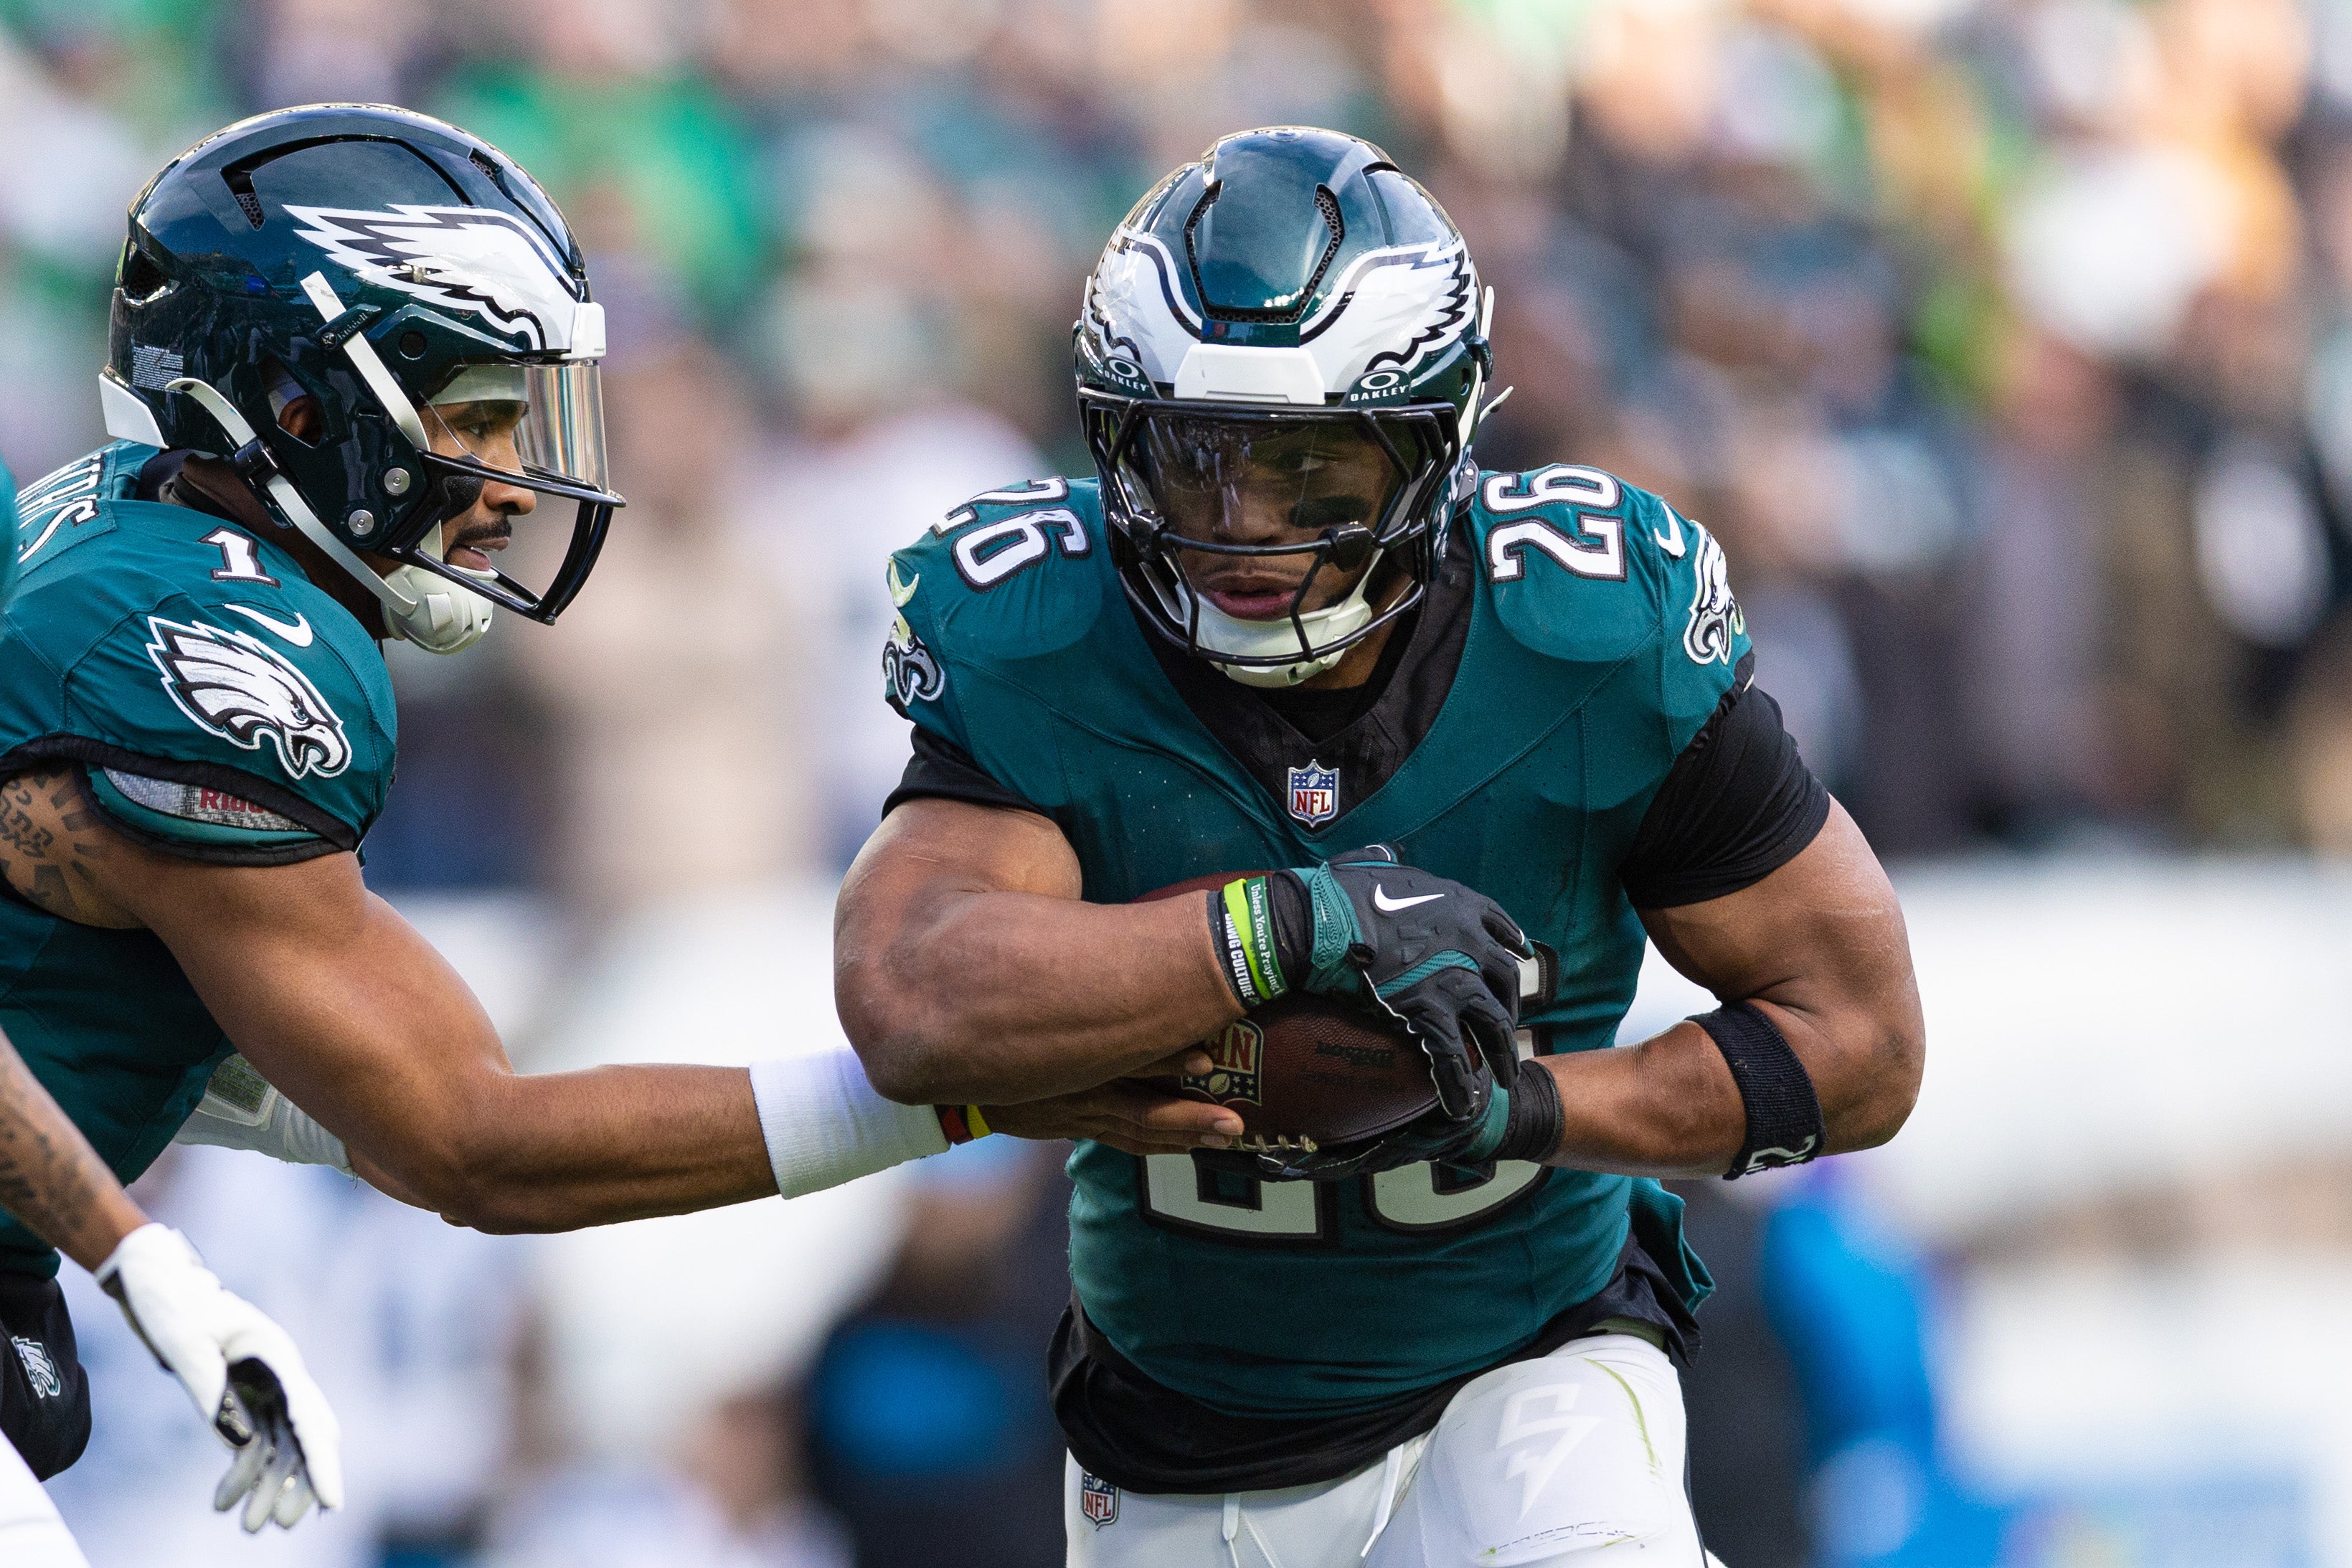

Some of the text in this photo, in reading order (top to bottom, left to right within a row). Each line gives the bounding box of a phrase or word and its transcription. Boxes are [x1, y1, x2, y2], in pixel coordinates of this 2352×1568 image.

[1104, 370, 1147, 392] OAKLEY
[1350, 385, 1407, 402] OAKLEY
[928, 476, 1092, 594] 26
[1482, 463, 1628, 585] 26
[197, 525, 282, 589] 1
[200, 788, 273, 816] Rid
[1295, 790, 1331, 816] NFL
[1250, 883, 1262, 915] Unless
[1255, 915, 1268, 950] You're
[1230, 949, 1255, 998] CULTURE
[1260, 950, 1280, 991] Praying
[1210, 1026, 1255, 1072] NF
[1085, 1492, 1112, 1519] NFL
